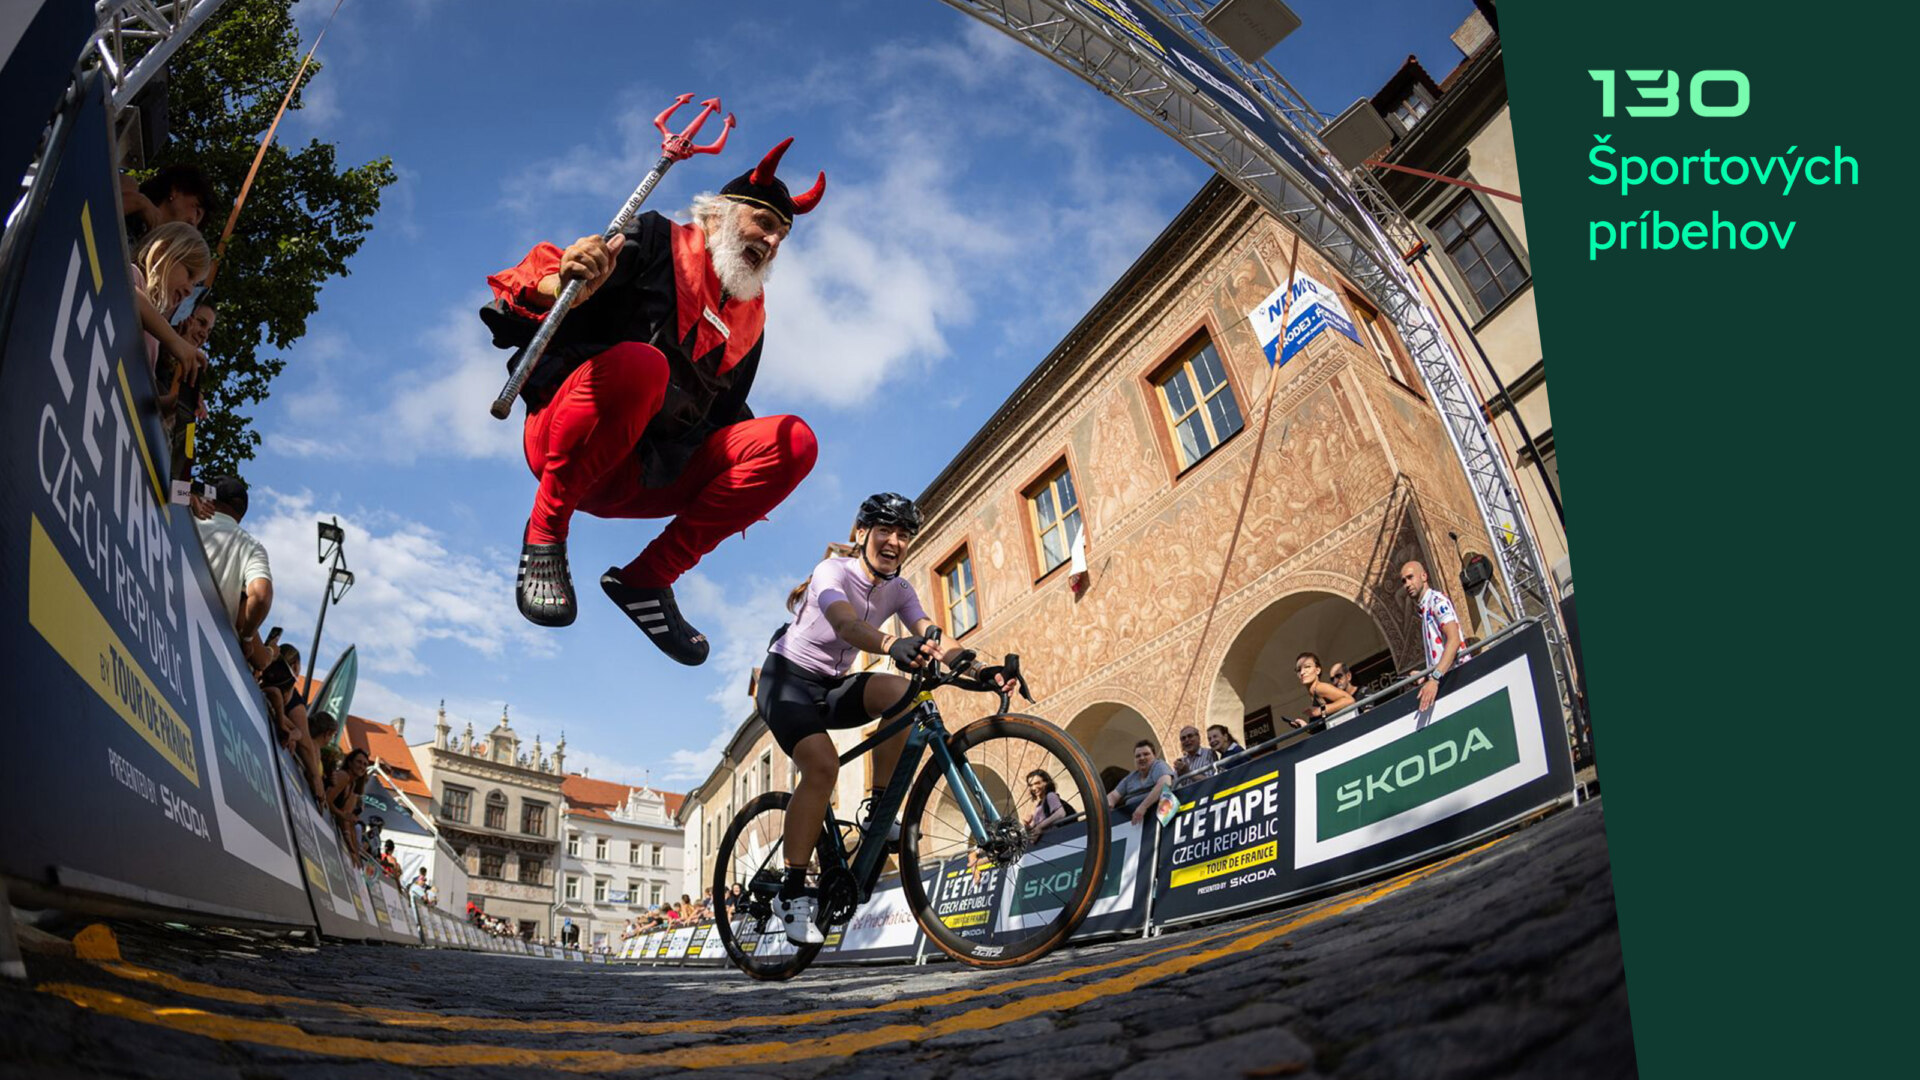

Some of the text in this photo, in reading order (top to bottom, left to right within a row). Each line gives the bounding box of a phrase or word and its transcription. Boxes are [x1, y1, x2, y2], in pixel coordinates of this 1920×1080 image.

[614, 172, 657, 227] Tour de France
[38, 404, 109, 594] CZECH
[115, 544, 187, 706] REPUBLIC
[110, 643, 145, 724] TOUR
[144, 687, 160, 739] DE
[158, 704, 195, 773] FRANCE
[1172, 817, 1279, 865] CZECH REPUBLIC
[1206, 858, 1228, 875] TOUR
[1228, 855, 1239, 868] DE
[1240, 845, 1274, 865] FRANCE
